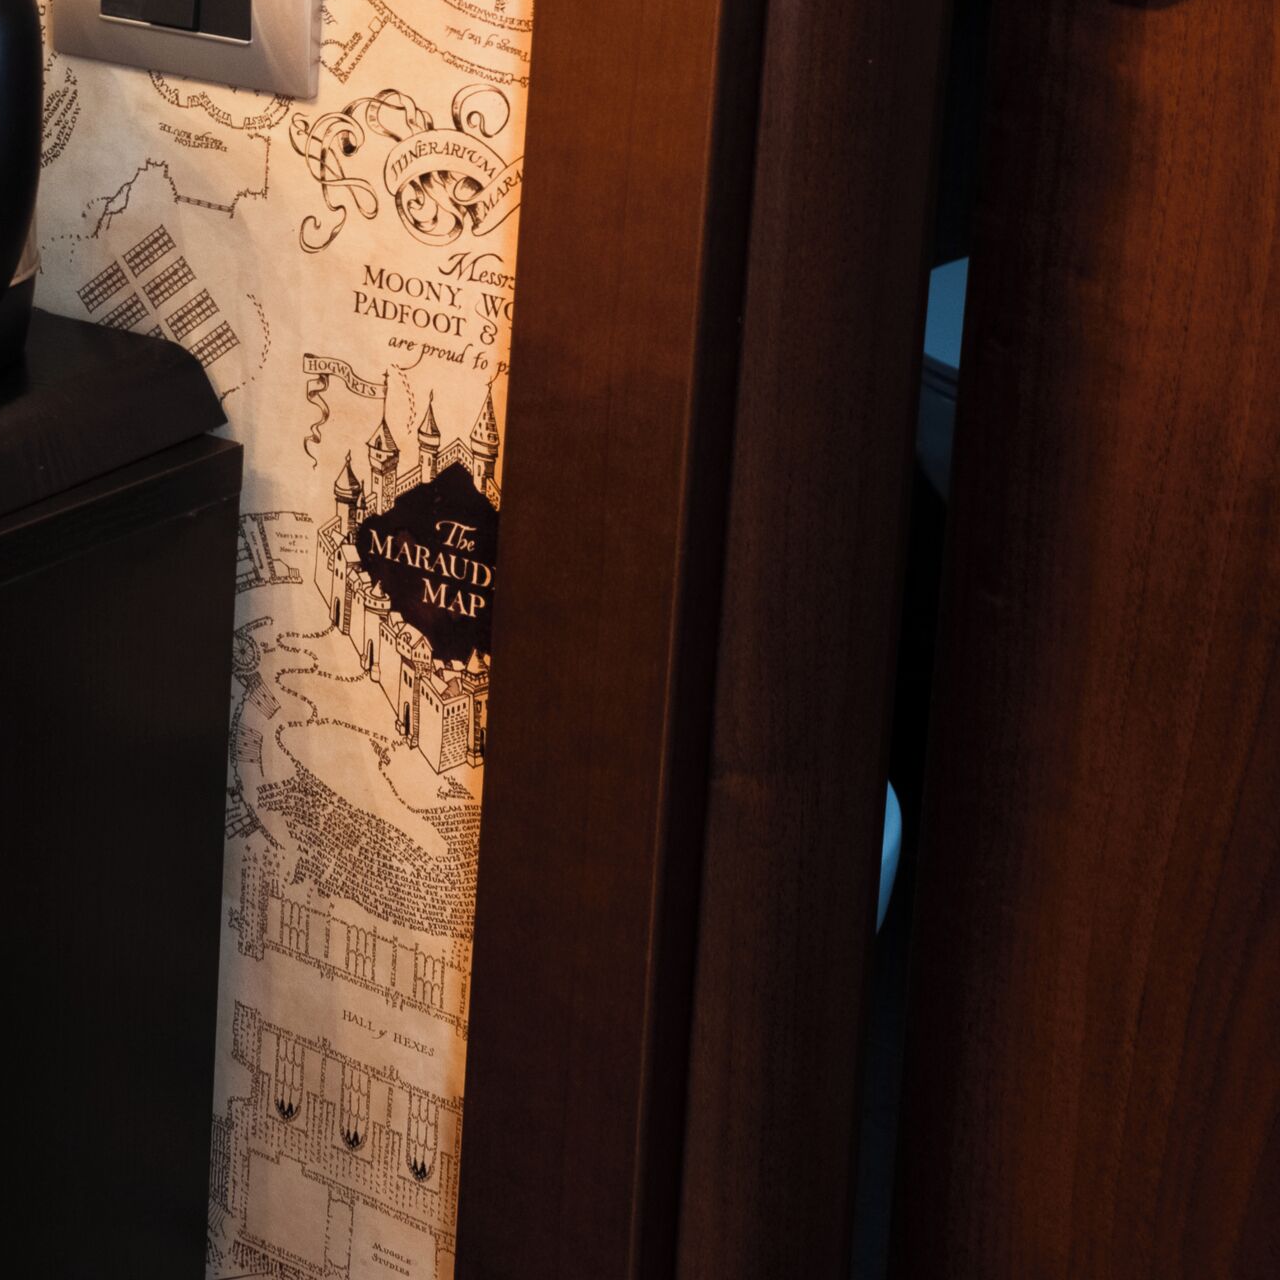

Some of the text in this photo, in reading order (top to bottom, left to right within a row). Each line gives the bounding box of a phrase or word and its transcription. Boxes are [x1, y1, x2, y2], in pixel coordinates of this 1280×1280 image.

[362, 264, 463, 310] MOONY,
[353, 290, 467, 337] PADFOOT
[388, 336, 417, 351] are
[308, 360, 377, 397] HOGWARTS
[436, 520, 477, 552] The
[369, 528, 496, 590] MARAUD
[421, 577, 486, 618] MAP
[342, 1009, 376, 1033] HALL
[393, 1032, 435, 1057] HEXES
